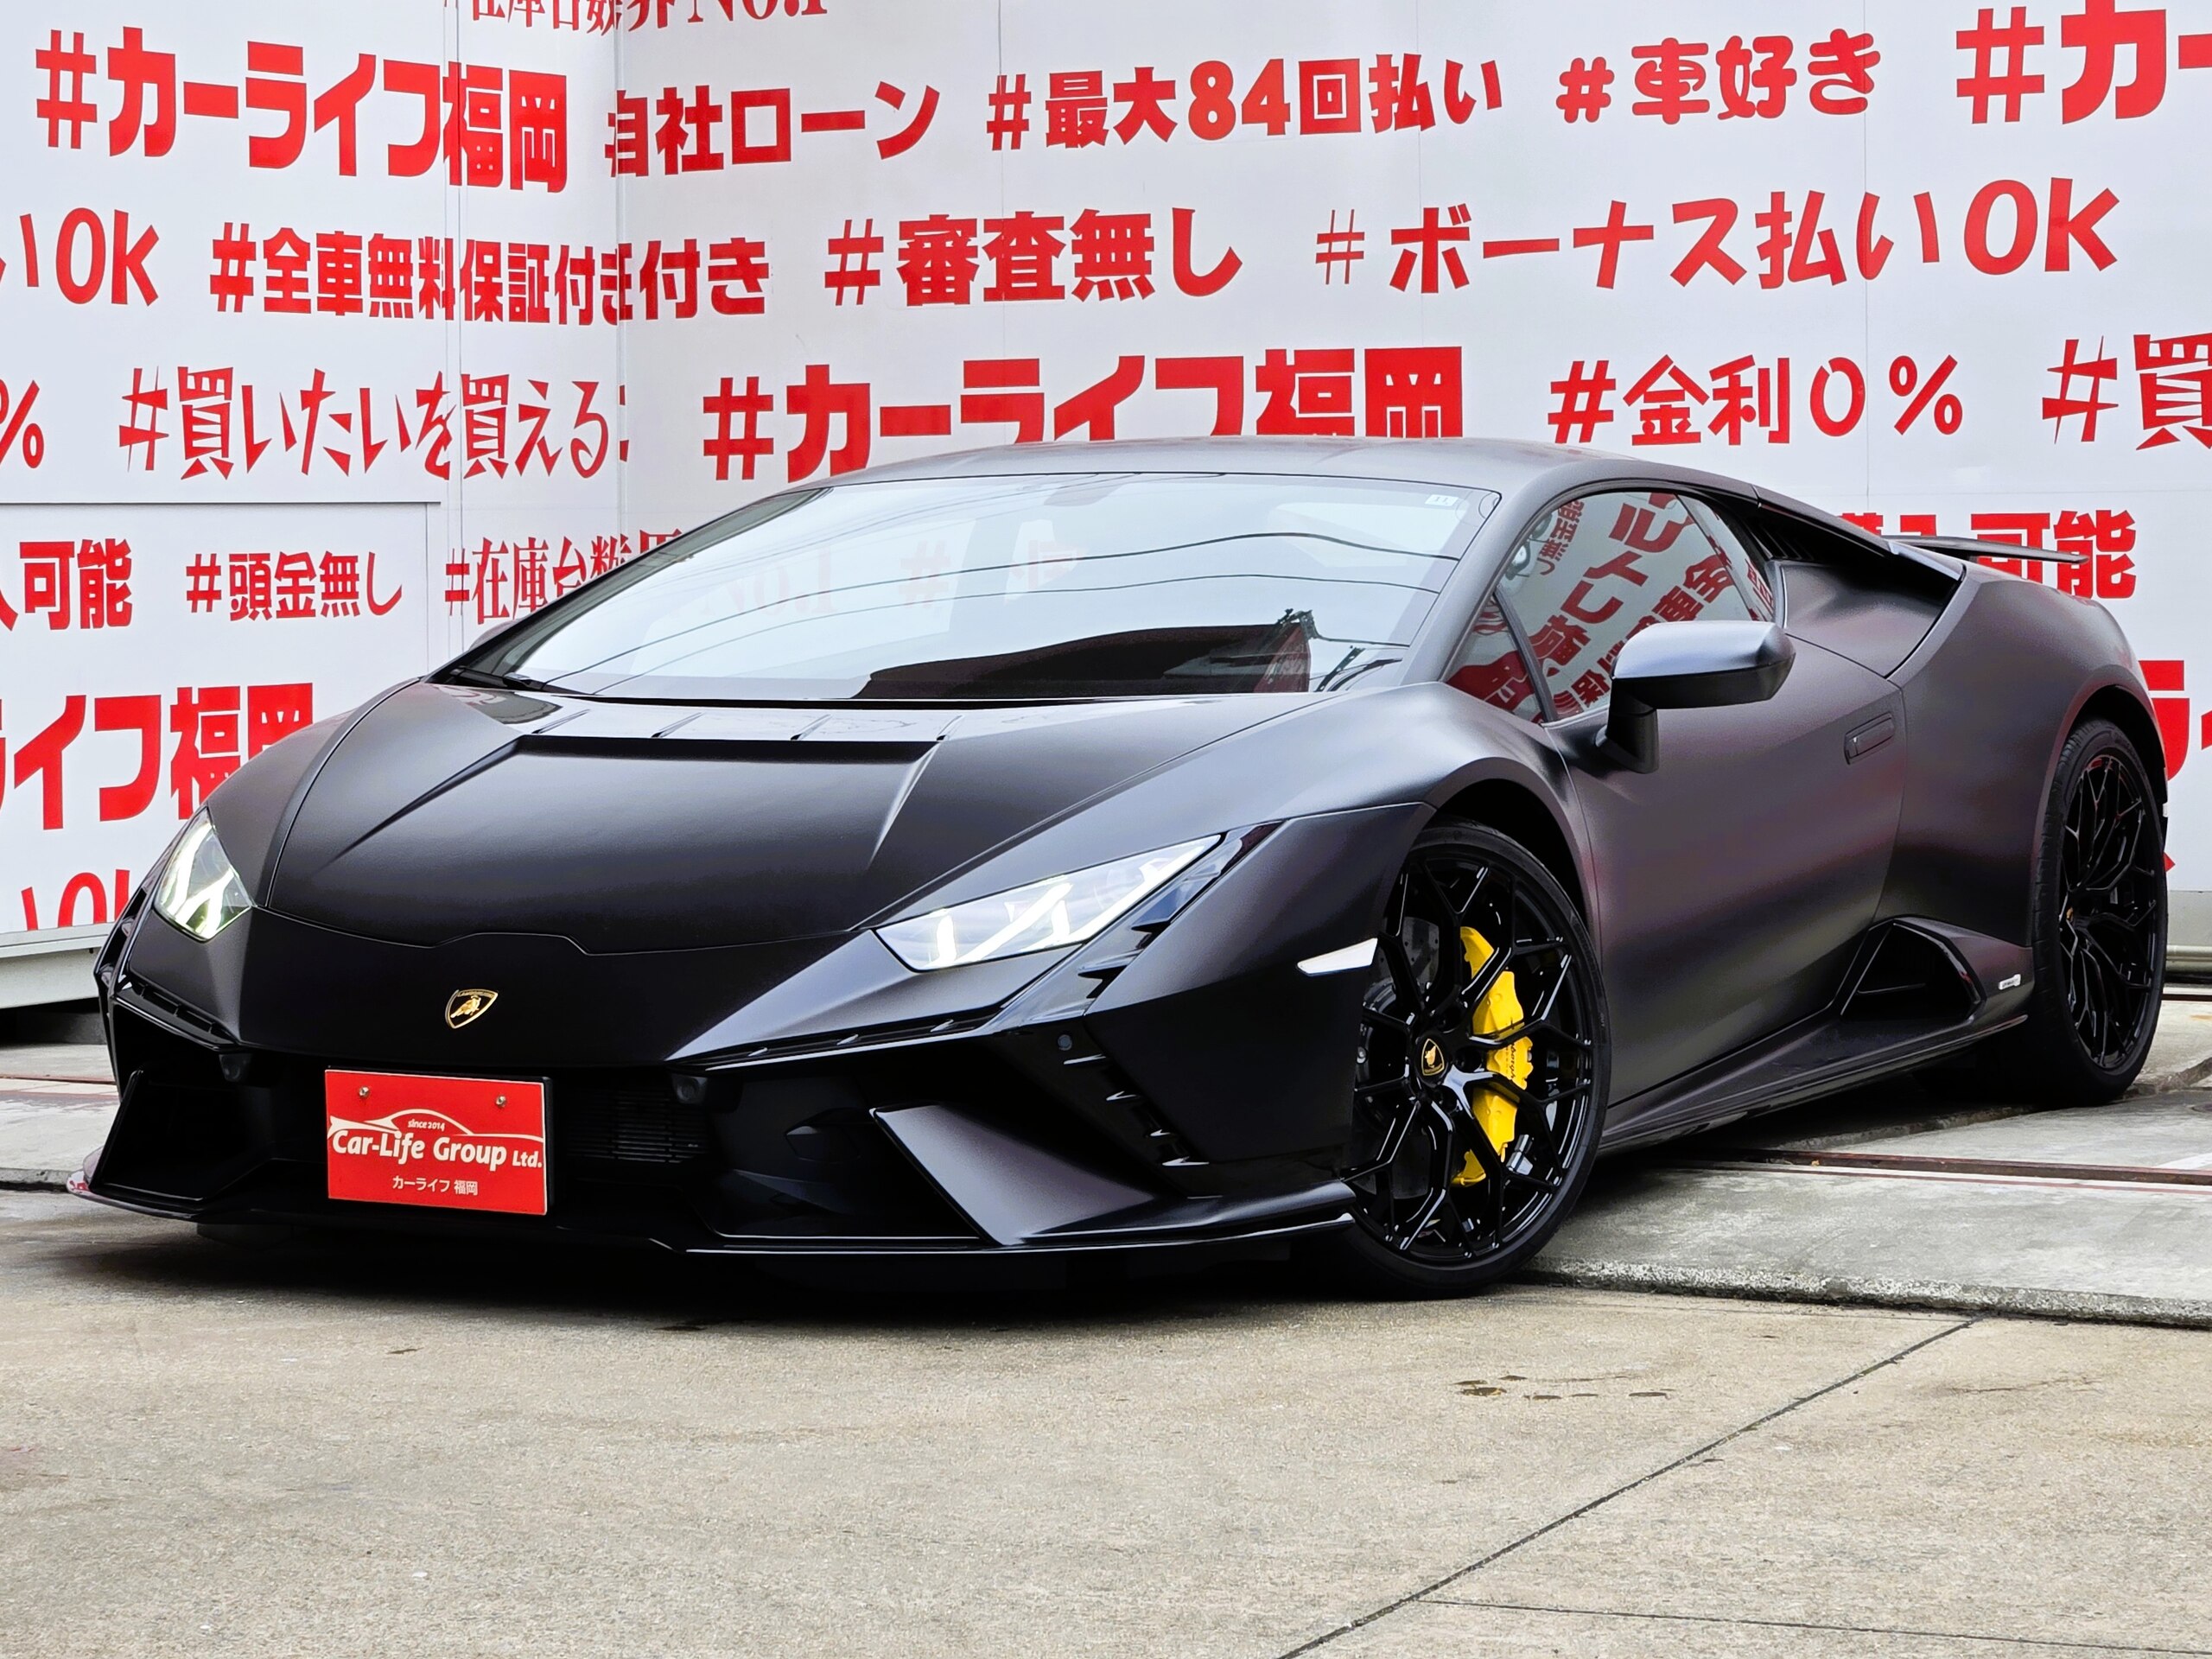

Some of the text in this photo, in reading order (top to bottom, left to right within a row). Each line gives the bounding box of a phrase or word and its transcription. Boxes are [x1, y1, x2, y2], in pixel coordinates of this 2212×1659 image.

[35, 27, 567, 194] #カーライフ福岡
[986, 53, 1502, 150] #最大84回払い
[1556, 29, 1881, 124] #車好き
[824, 208, 1243, 307] #審査無し
[119, 366, 609, 480] #買いたいを買える
[703, 346, 1463, 482] #カーライフ福岡
[2043, 333, 2212, 450] #買
[0, 537, 132, 632] 可能
[186, 551, 403, 623] #頭金無し
[333, 1129, 543, 1172] Car-Life Group Ltd.
[408, 1118, 445, 1131] since 2014
[392, 1175, 479, 1196] カーライフ 福岡
